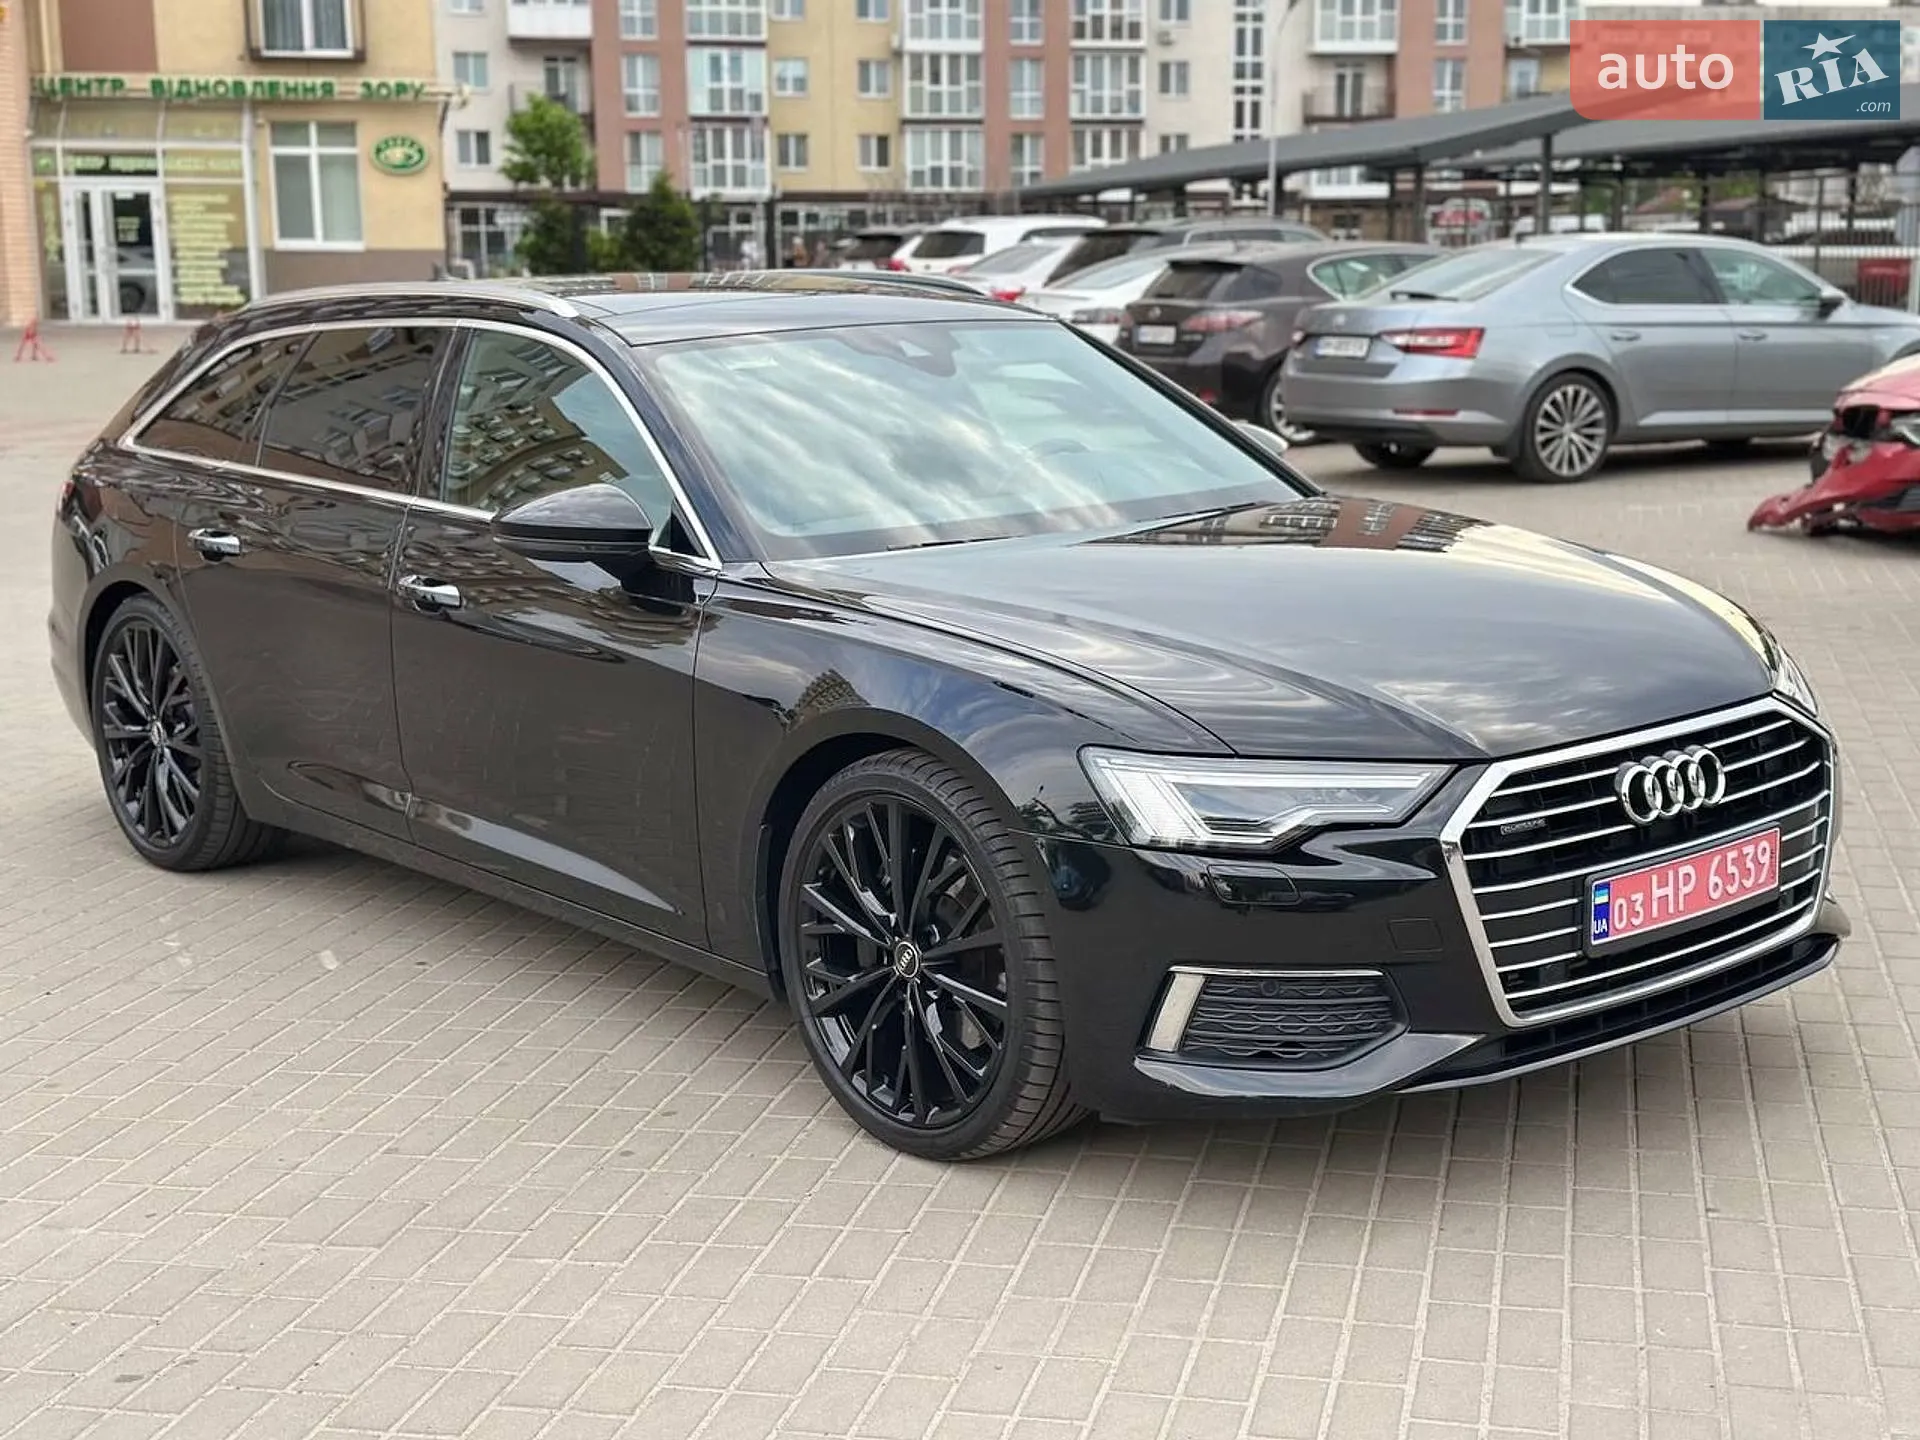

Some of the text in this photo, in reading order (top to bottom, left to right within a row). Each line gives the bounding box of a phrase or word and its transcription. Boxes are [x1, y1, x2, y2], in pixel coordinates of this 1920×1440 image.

[36, 77, 426, 100] ЦЕНТР ВІДНОВЛЕННЯ ЗОРУ
[1613, 840, 1771, 930] 03 HP 6539
[1593, 919, 1608, 934] UA
